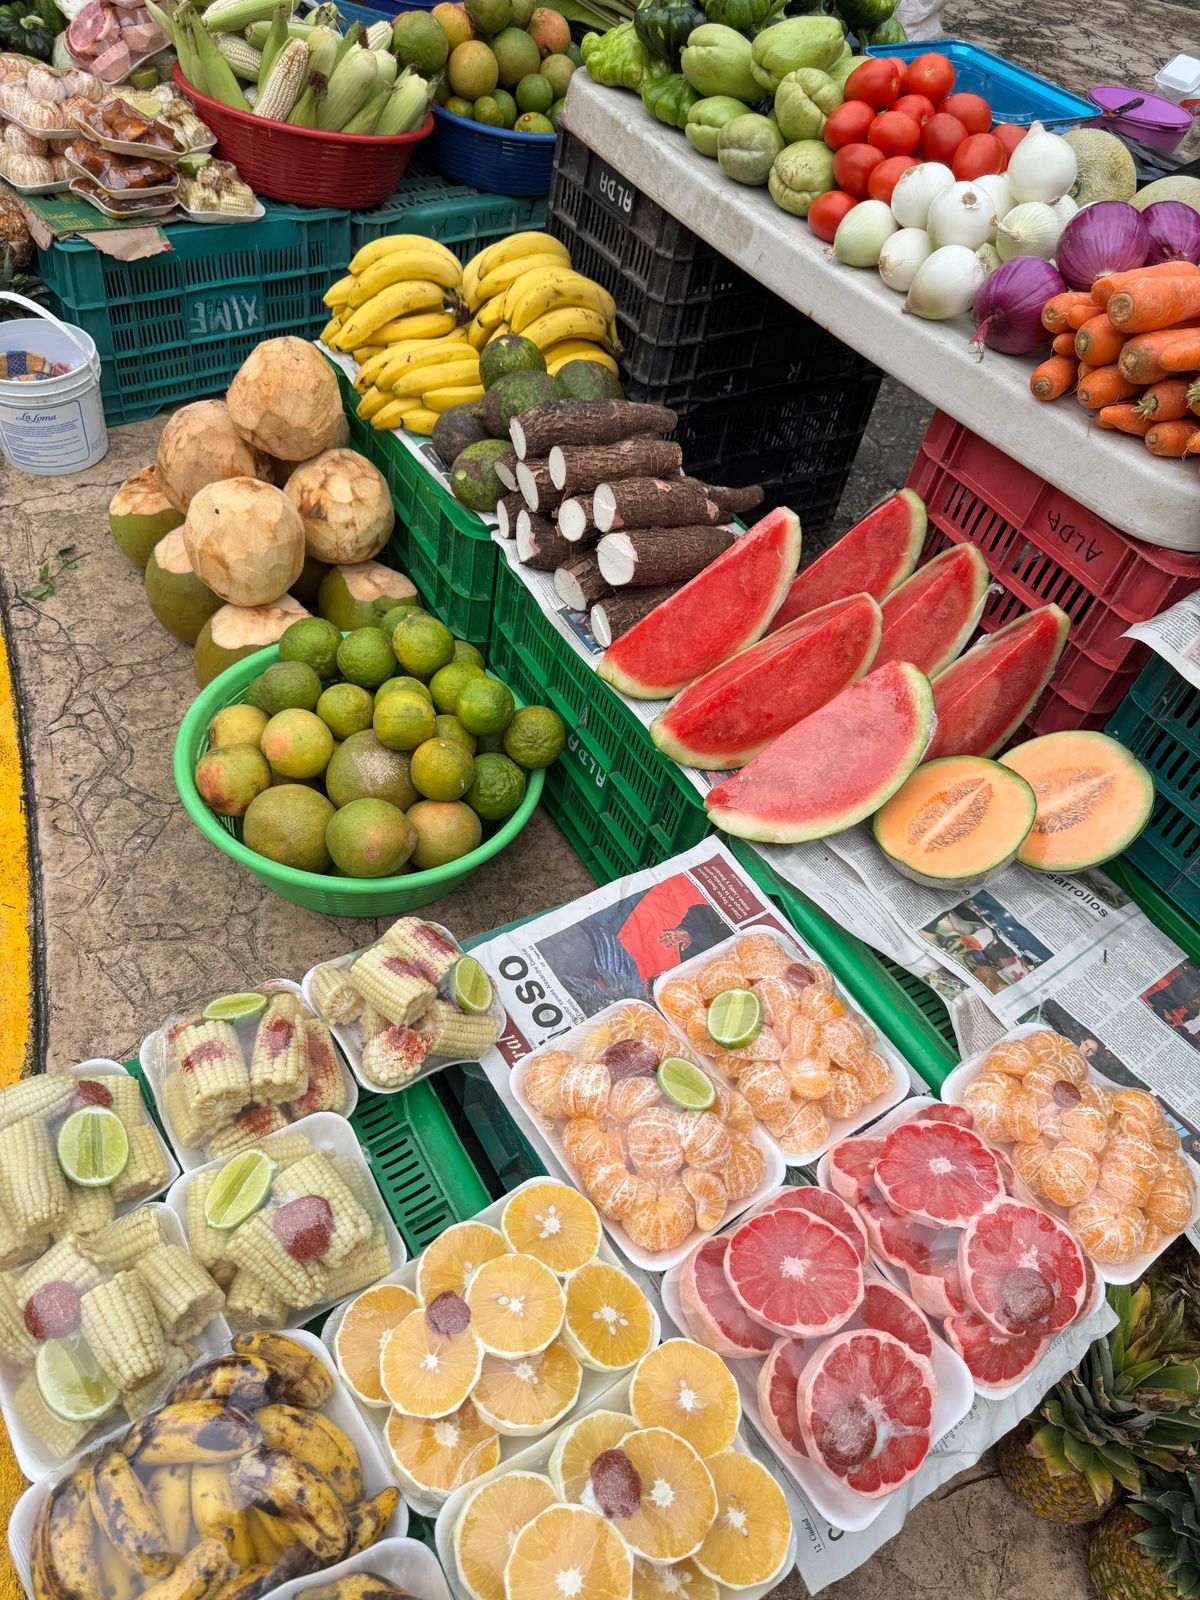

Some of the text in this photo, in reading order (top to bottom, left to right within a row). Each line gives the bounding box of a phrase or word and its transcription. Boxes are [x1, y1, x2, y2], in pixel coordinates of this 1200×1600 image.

[600, 171, 632, 213] ALDA
[190, 294, 258, 334] XIME
[16, 412, 57, 424] La Loma
[1048, 510, 1104, 562] ALDA
[567, 734, 606, 788] ALDA
[707, 878, 718, 891] Swift
[716, 890, 728, 905] Taylor
[728, 884, 740, 898] Lively
[1042, 872, 1108, 917] sarrollos
[801, 1518, 823, 1553] 12 Ciudad
